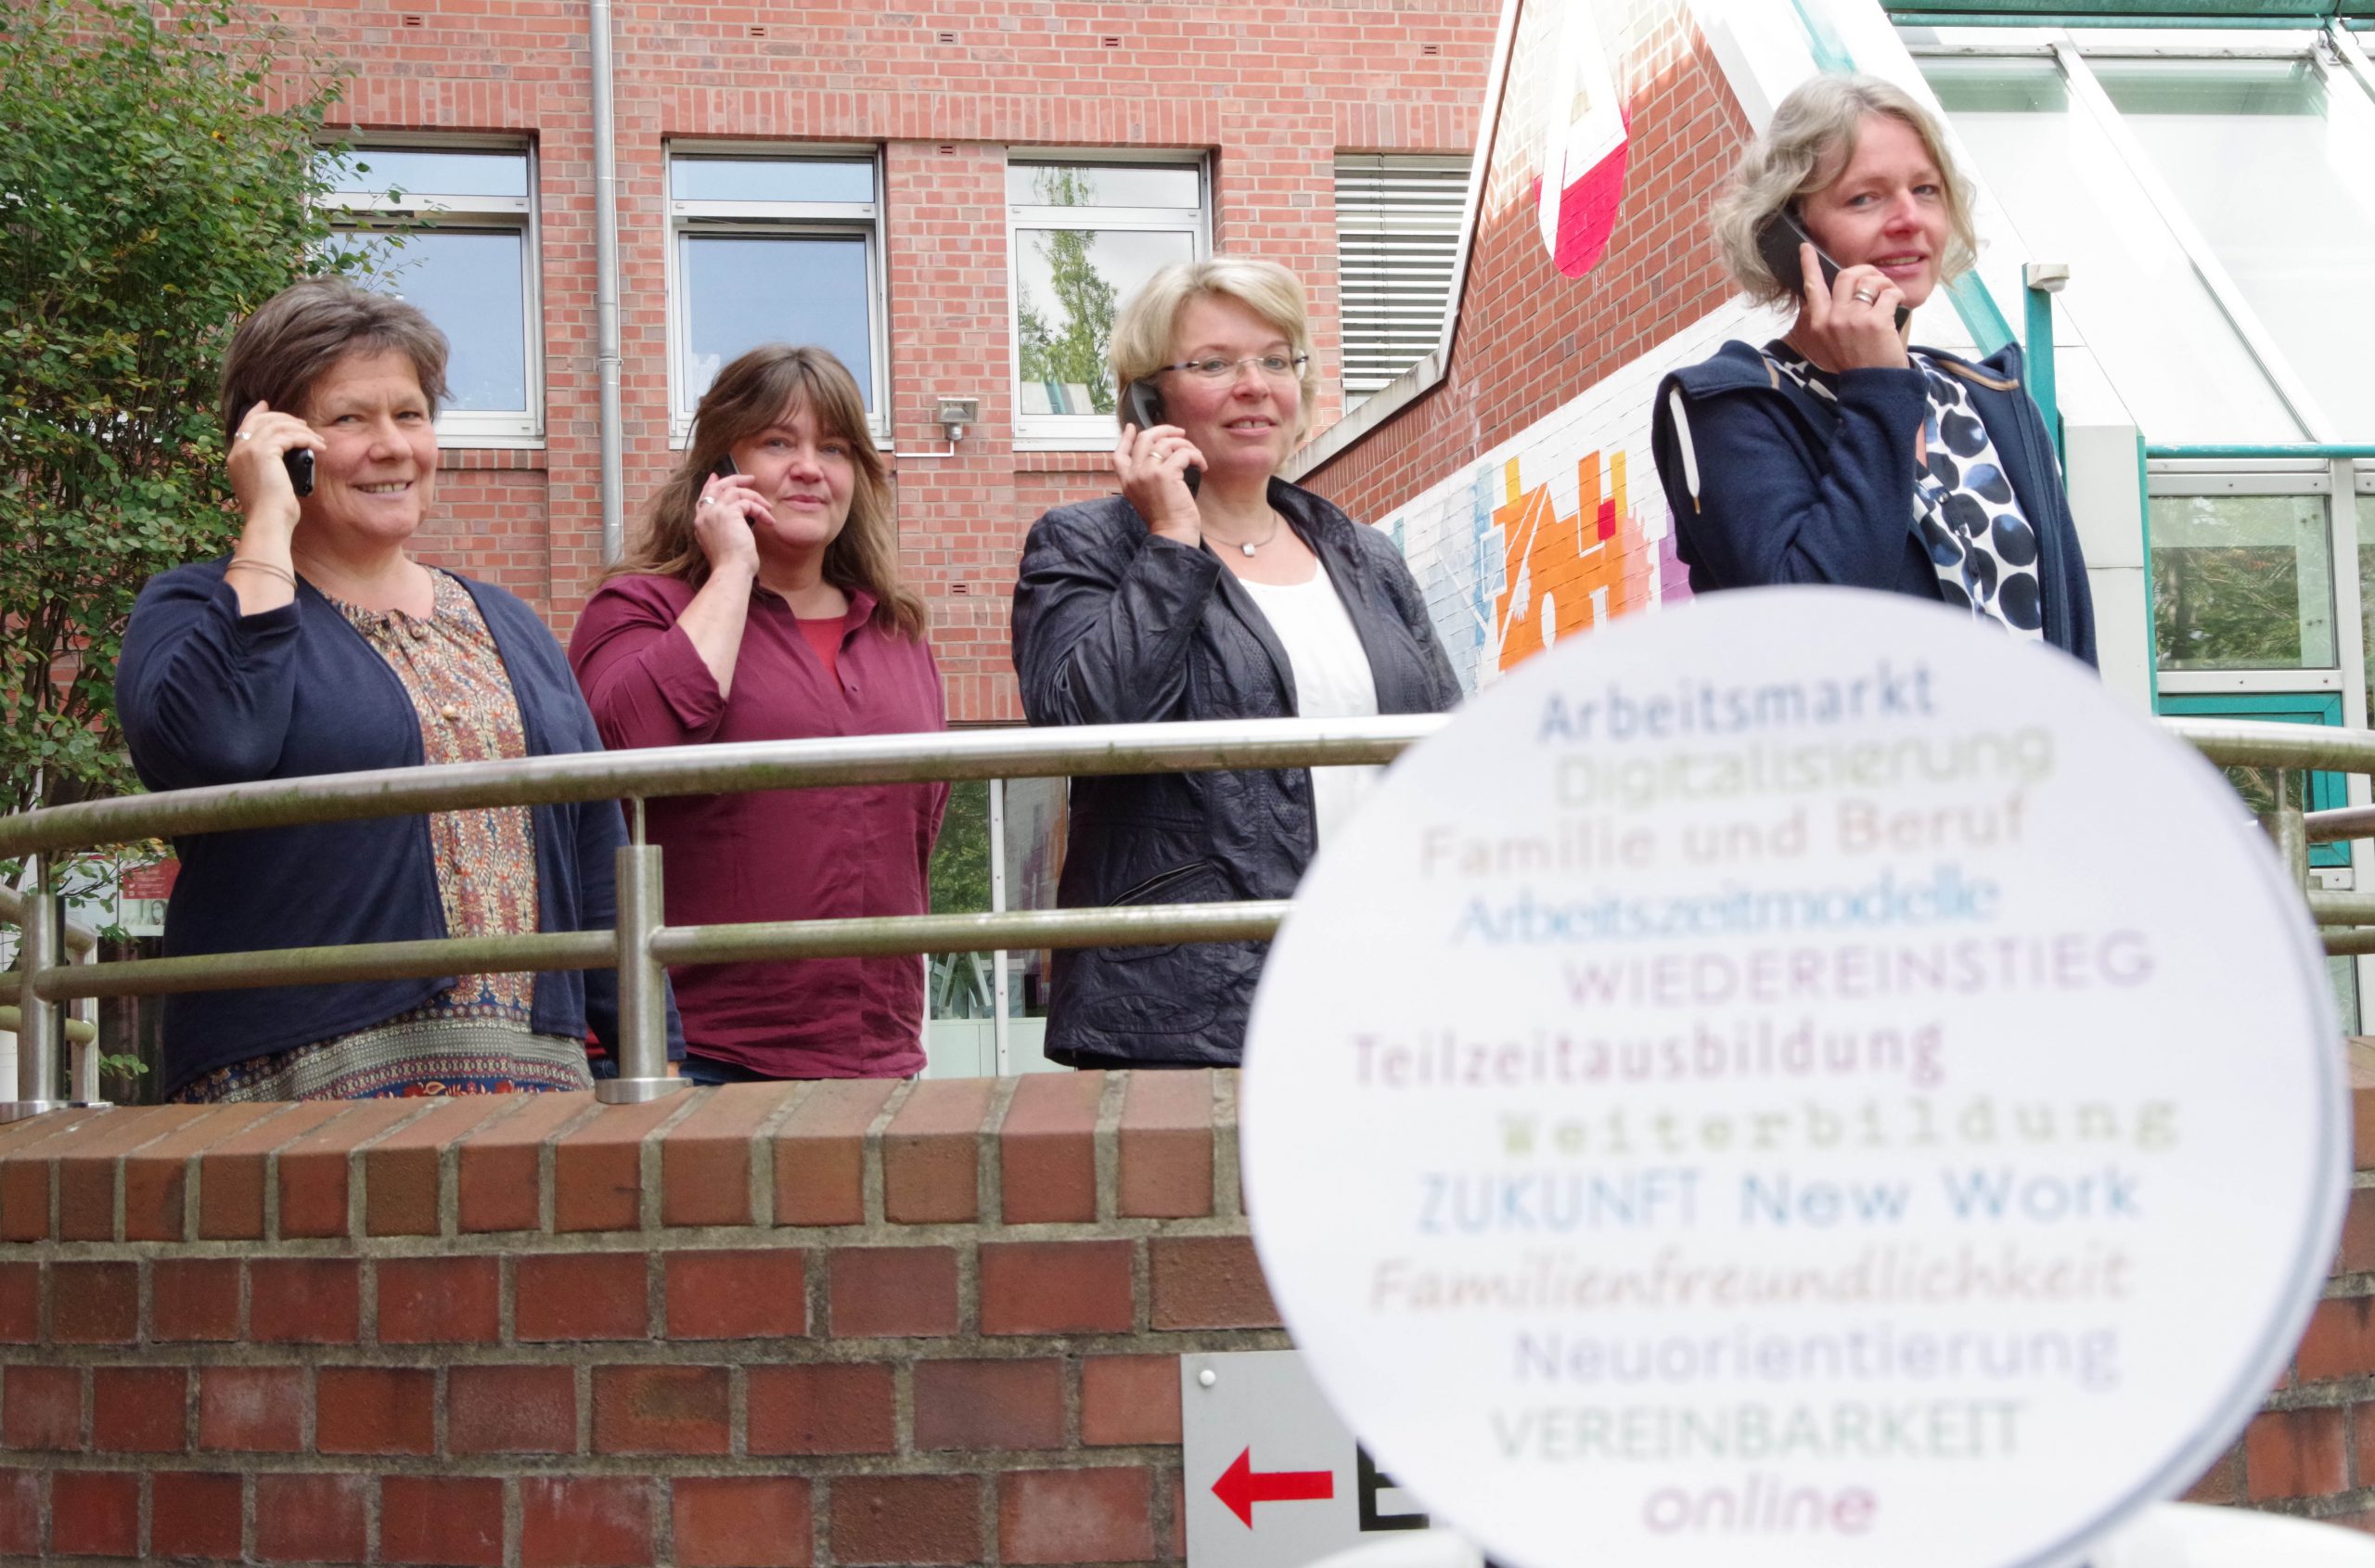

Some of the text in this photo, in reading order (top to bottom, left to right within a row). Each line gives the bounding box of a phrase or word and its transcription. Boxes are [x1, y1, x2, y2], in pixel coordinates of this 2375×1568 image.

[1538, 659, 1938, 745] Arbeitsmarkt
[1556, 726, 2055, 810] Digitalisierung
[1420, 790, 2026, 878] Familie und Beruf
[1451, 864, 2002, 945] Arbeitszeitmodelle
[1566, 930, 2156, 1007] WIEDEREINSTIEG
[1354, 1019, 1945, 1089] Teilzeitausbildung
[1500, 1099, 2181, 1156] Weiterbildung
[1419, 1162, 2141, 1234] ZUKUNFT New Work
[1370, 1240, 2134, 1314] Familienfreundlichkeit
[1515, 1321, 2122, 1392] Neuorientierung
[1491, 1399, 2026, 1462] VEREINBARKEIT
[1643, 1473, 1879, 1536] online
